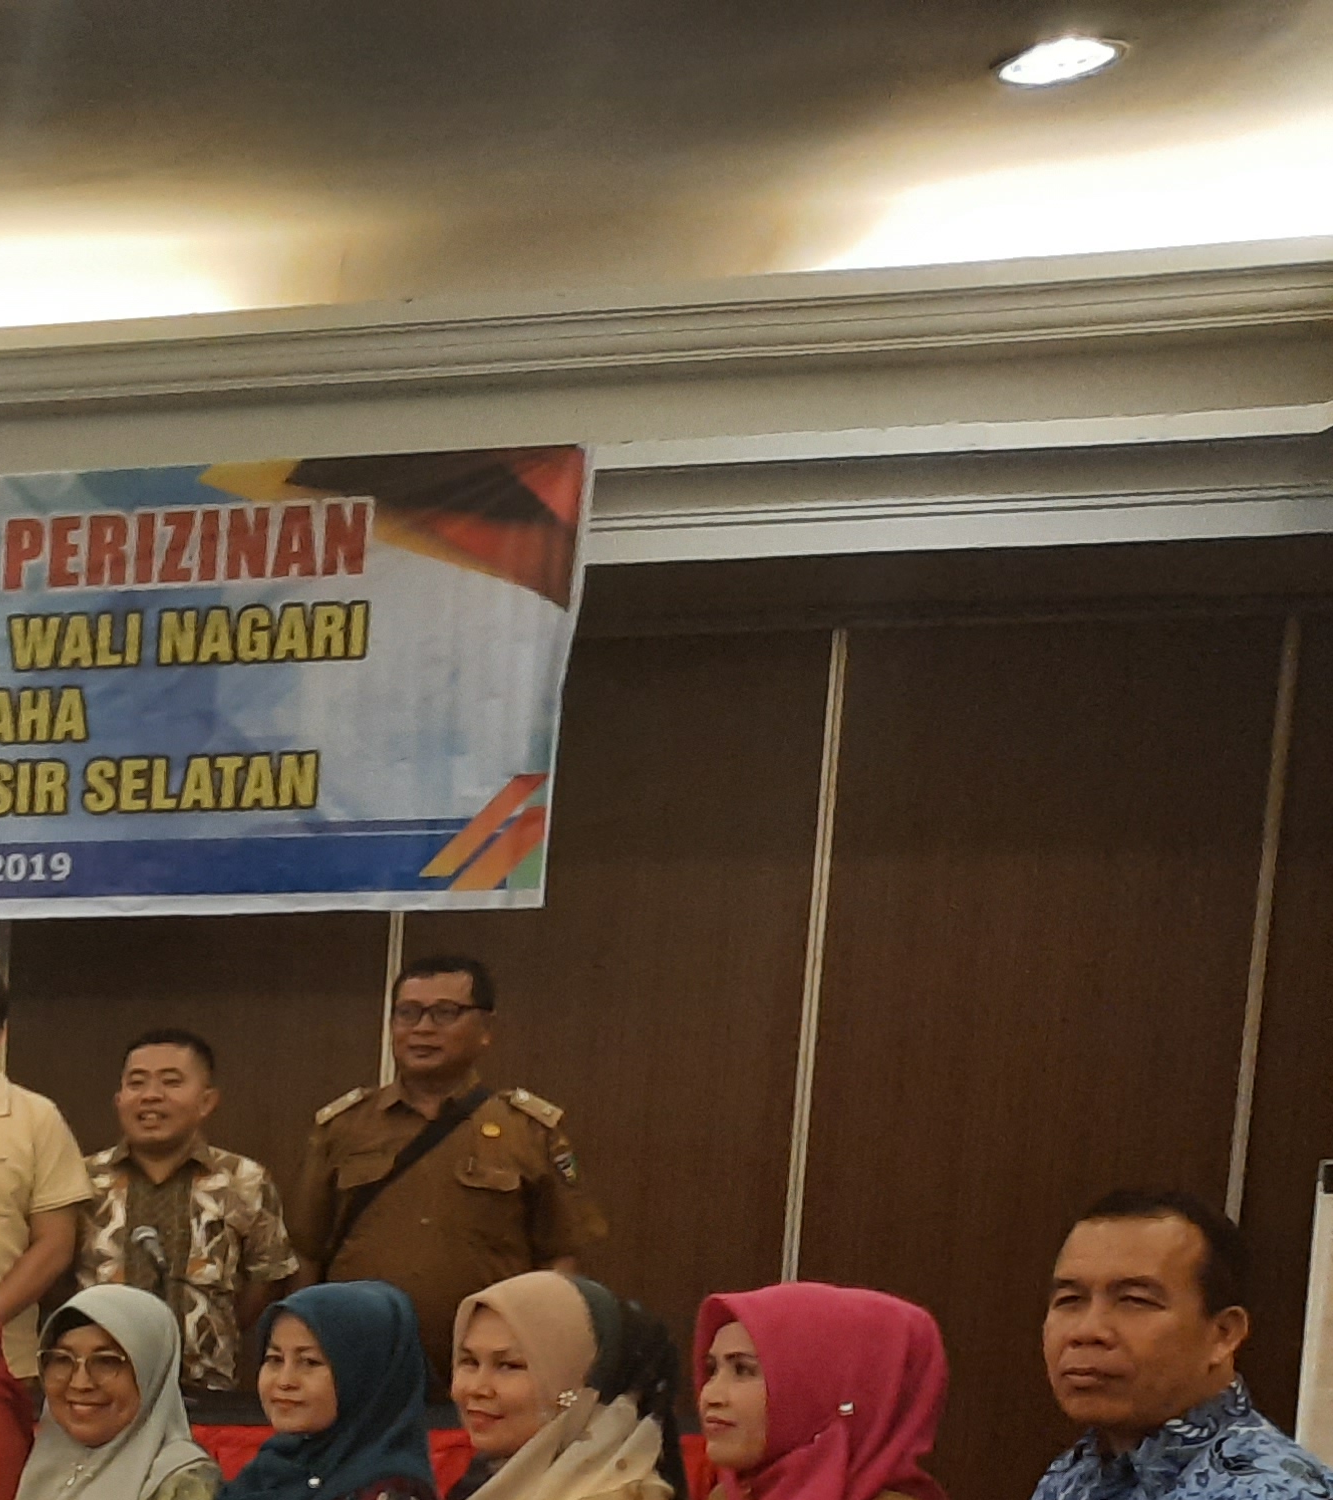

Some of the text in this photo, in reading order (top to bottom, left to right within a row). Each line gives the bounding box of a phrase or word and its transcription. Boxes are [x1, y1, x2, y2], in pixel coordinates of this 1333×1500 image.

[2, 503, 368, 590] PERIZINAN
[7, 610, 143, 671] WALI
[157, 601, 370, 665] NAGARI
[81, 750, 319, 815] SELATAN
